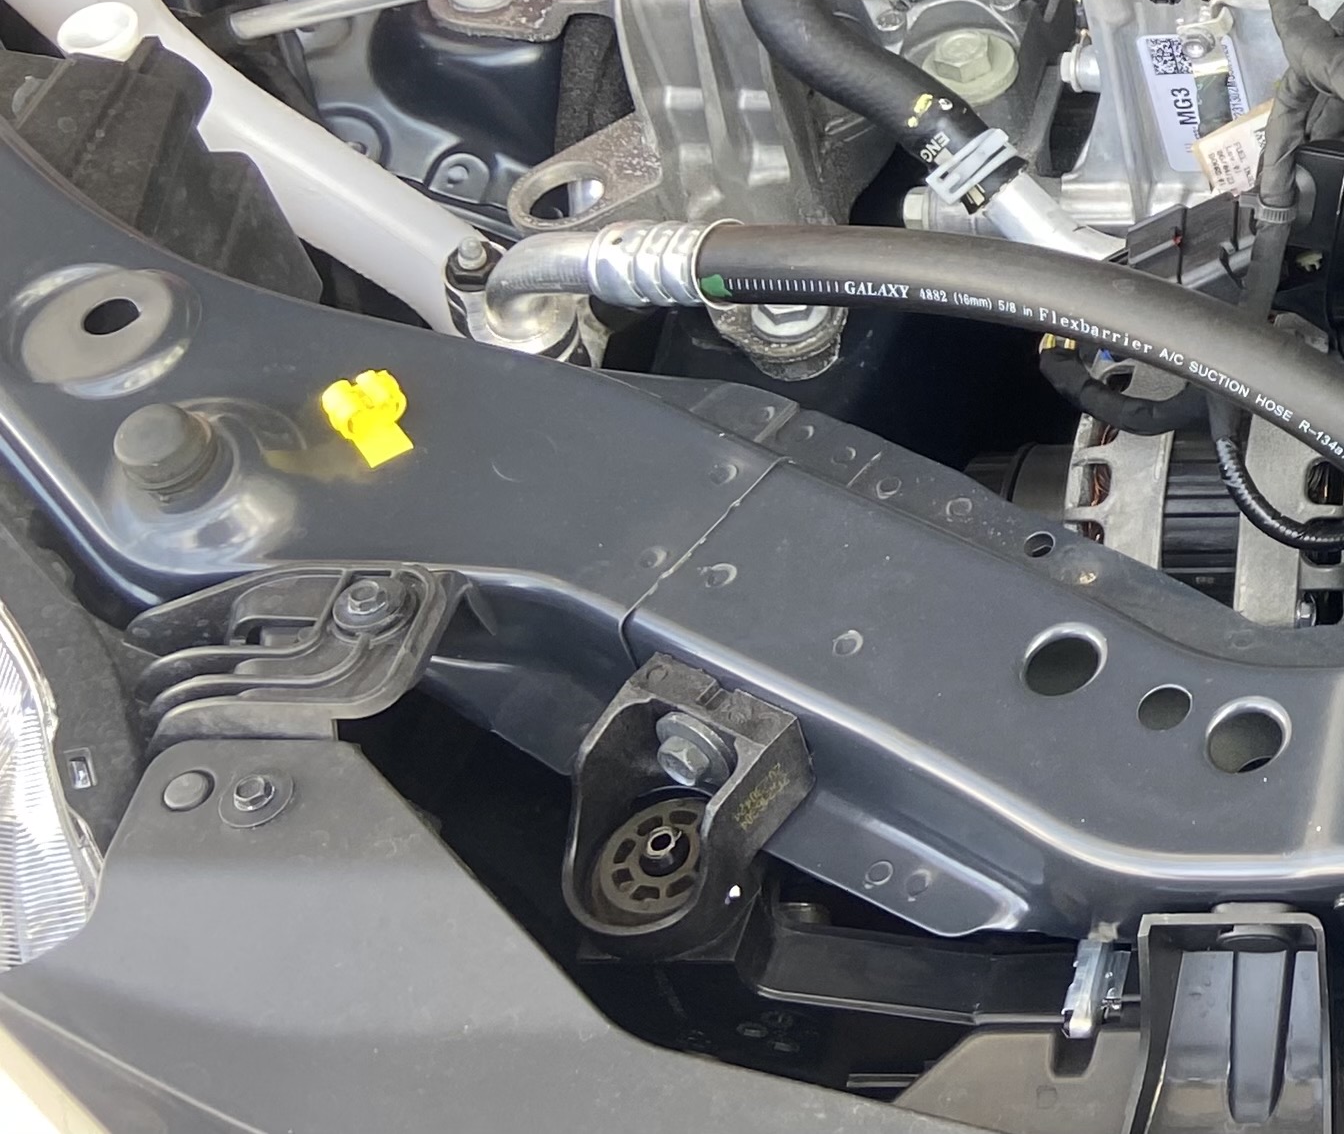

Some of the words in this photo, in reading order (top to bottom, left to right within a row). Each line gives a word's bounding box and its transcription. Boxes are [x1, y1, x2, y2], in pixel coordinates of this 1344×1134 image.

[1170, 87, 1199, 125] MG3
[919, 131, 951, 163] ENG
[844, 281, 909, 299] GALAXY
[919, 288, 949, 303] 4882
[953, 291, 992, 311] (16mm)
[998, 300, 1016, 314] 5/8
[1023, 304, 1034, 317] in
[1039, 307, 1152, 354] Flexbarrier
[1158, 347, 1185, 367] A/C
[1188, 360, 1250, 398] SUCTION
[1254, 393, 1294, 423] HOSE
